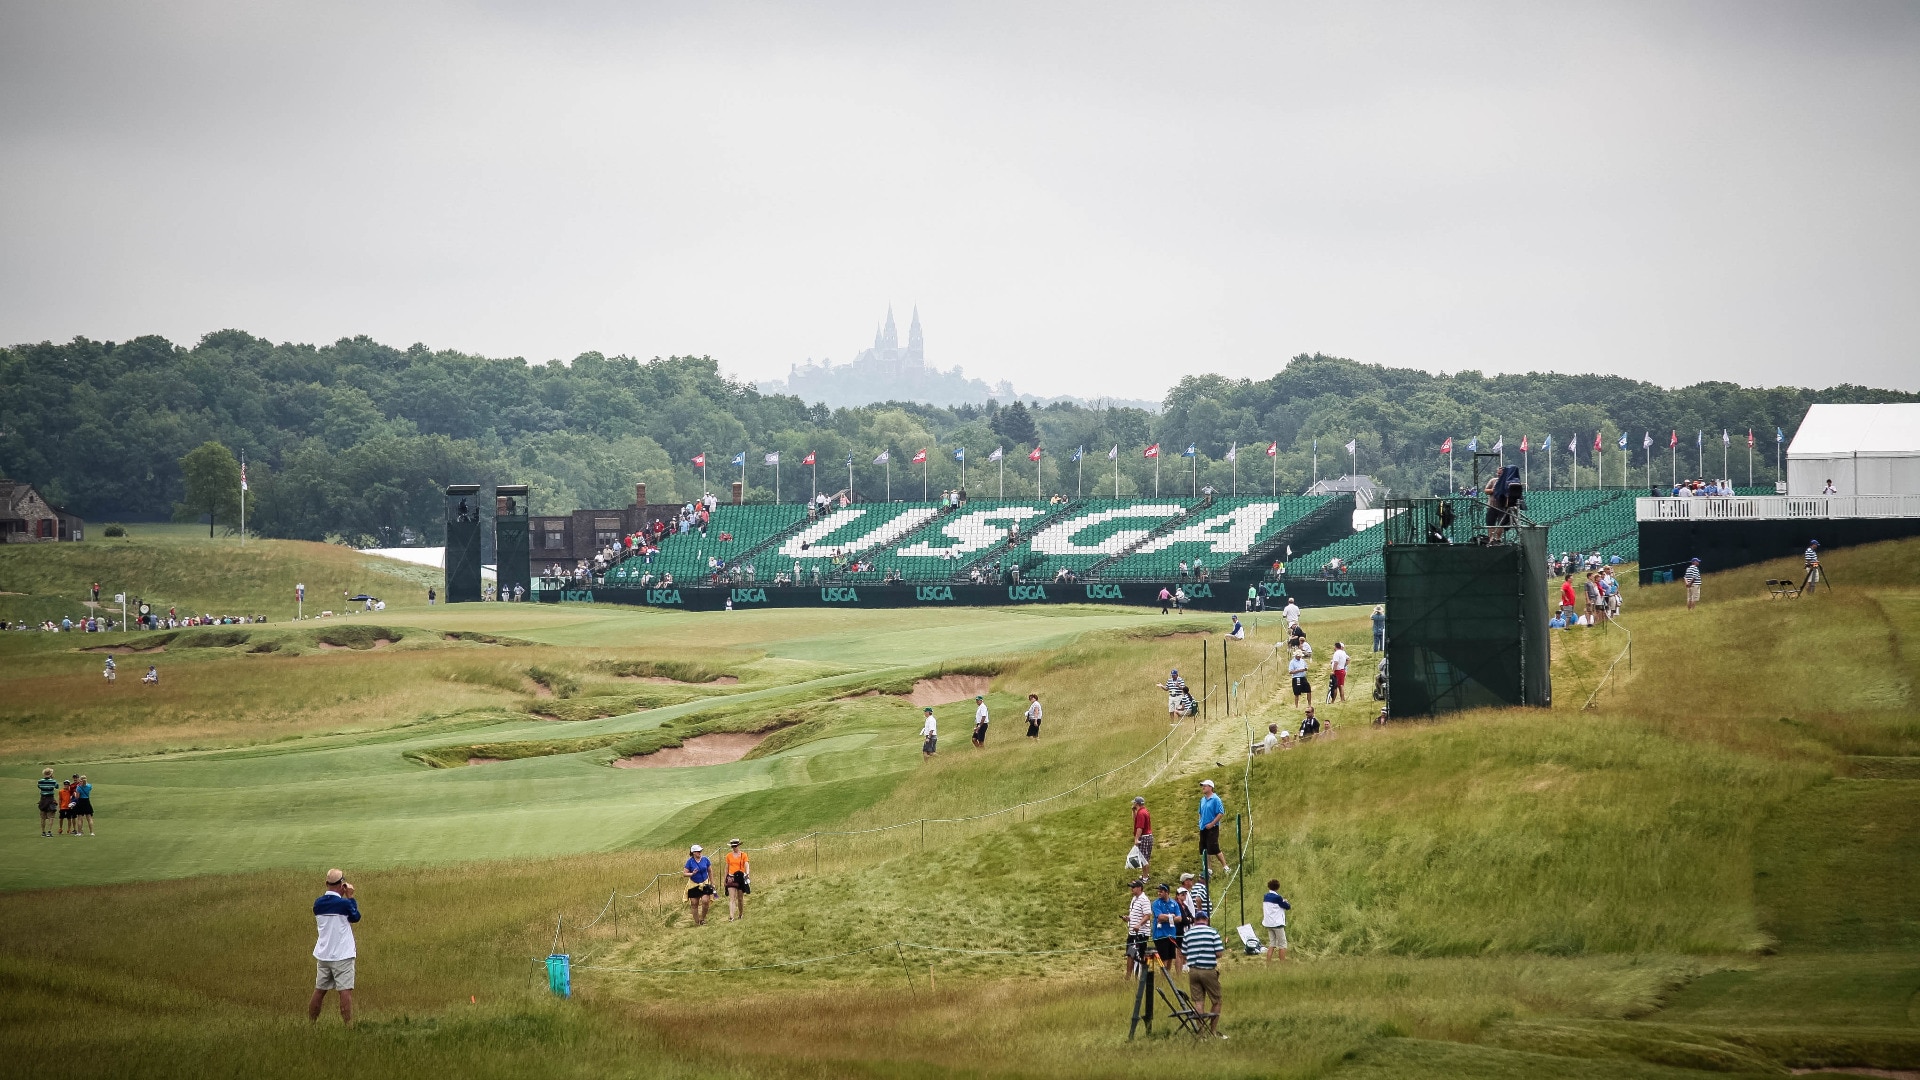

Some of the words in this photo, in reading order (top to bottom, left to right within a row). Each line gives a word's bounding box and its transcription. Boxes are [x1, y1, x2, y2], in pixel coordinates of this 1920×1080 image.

[779, 503, 1279, 557] USGA
[560, 591, 594, 602] USGA
[646, 590, 682, 603] USGA
[732, 588, 767, 602] USGA
[821, 588, 858, 602] USGA
[916, 586, 953, 600] USGA
[1008, 585, 1046, 600] USGA
[1086, 584, 1122, 599] USGA
[1264, 582, 1287, 597] SGA
[1327, 582, 1356, 597] USGA
